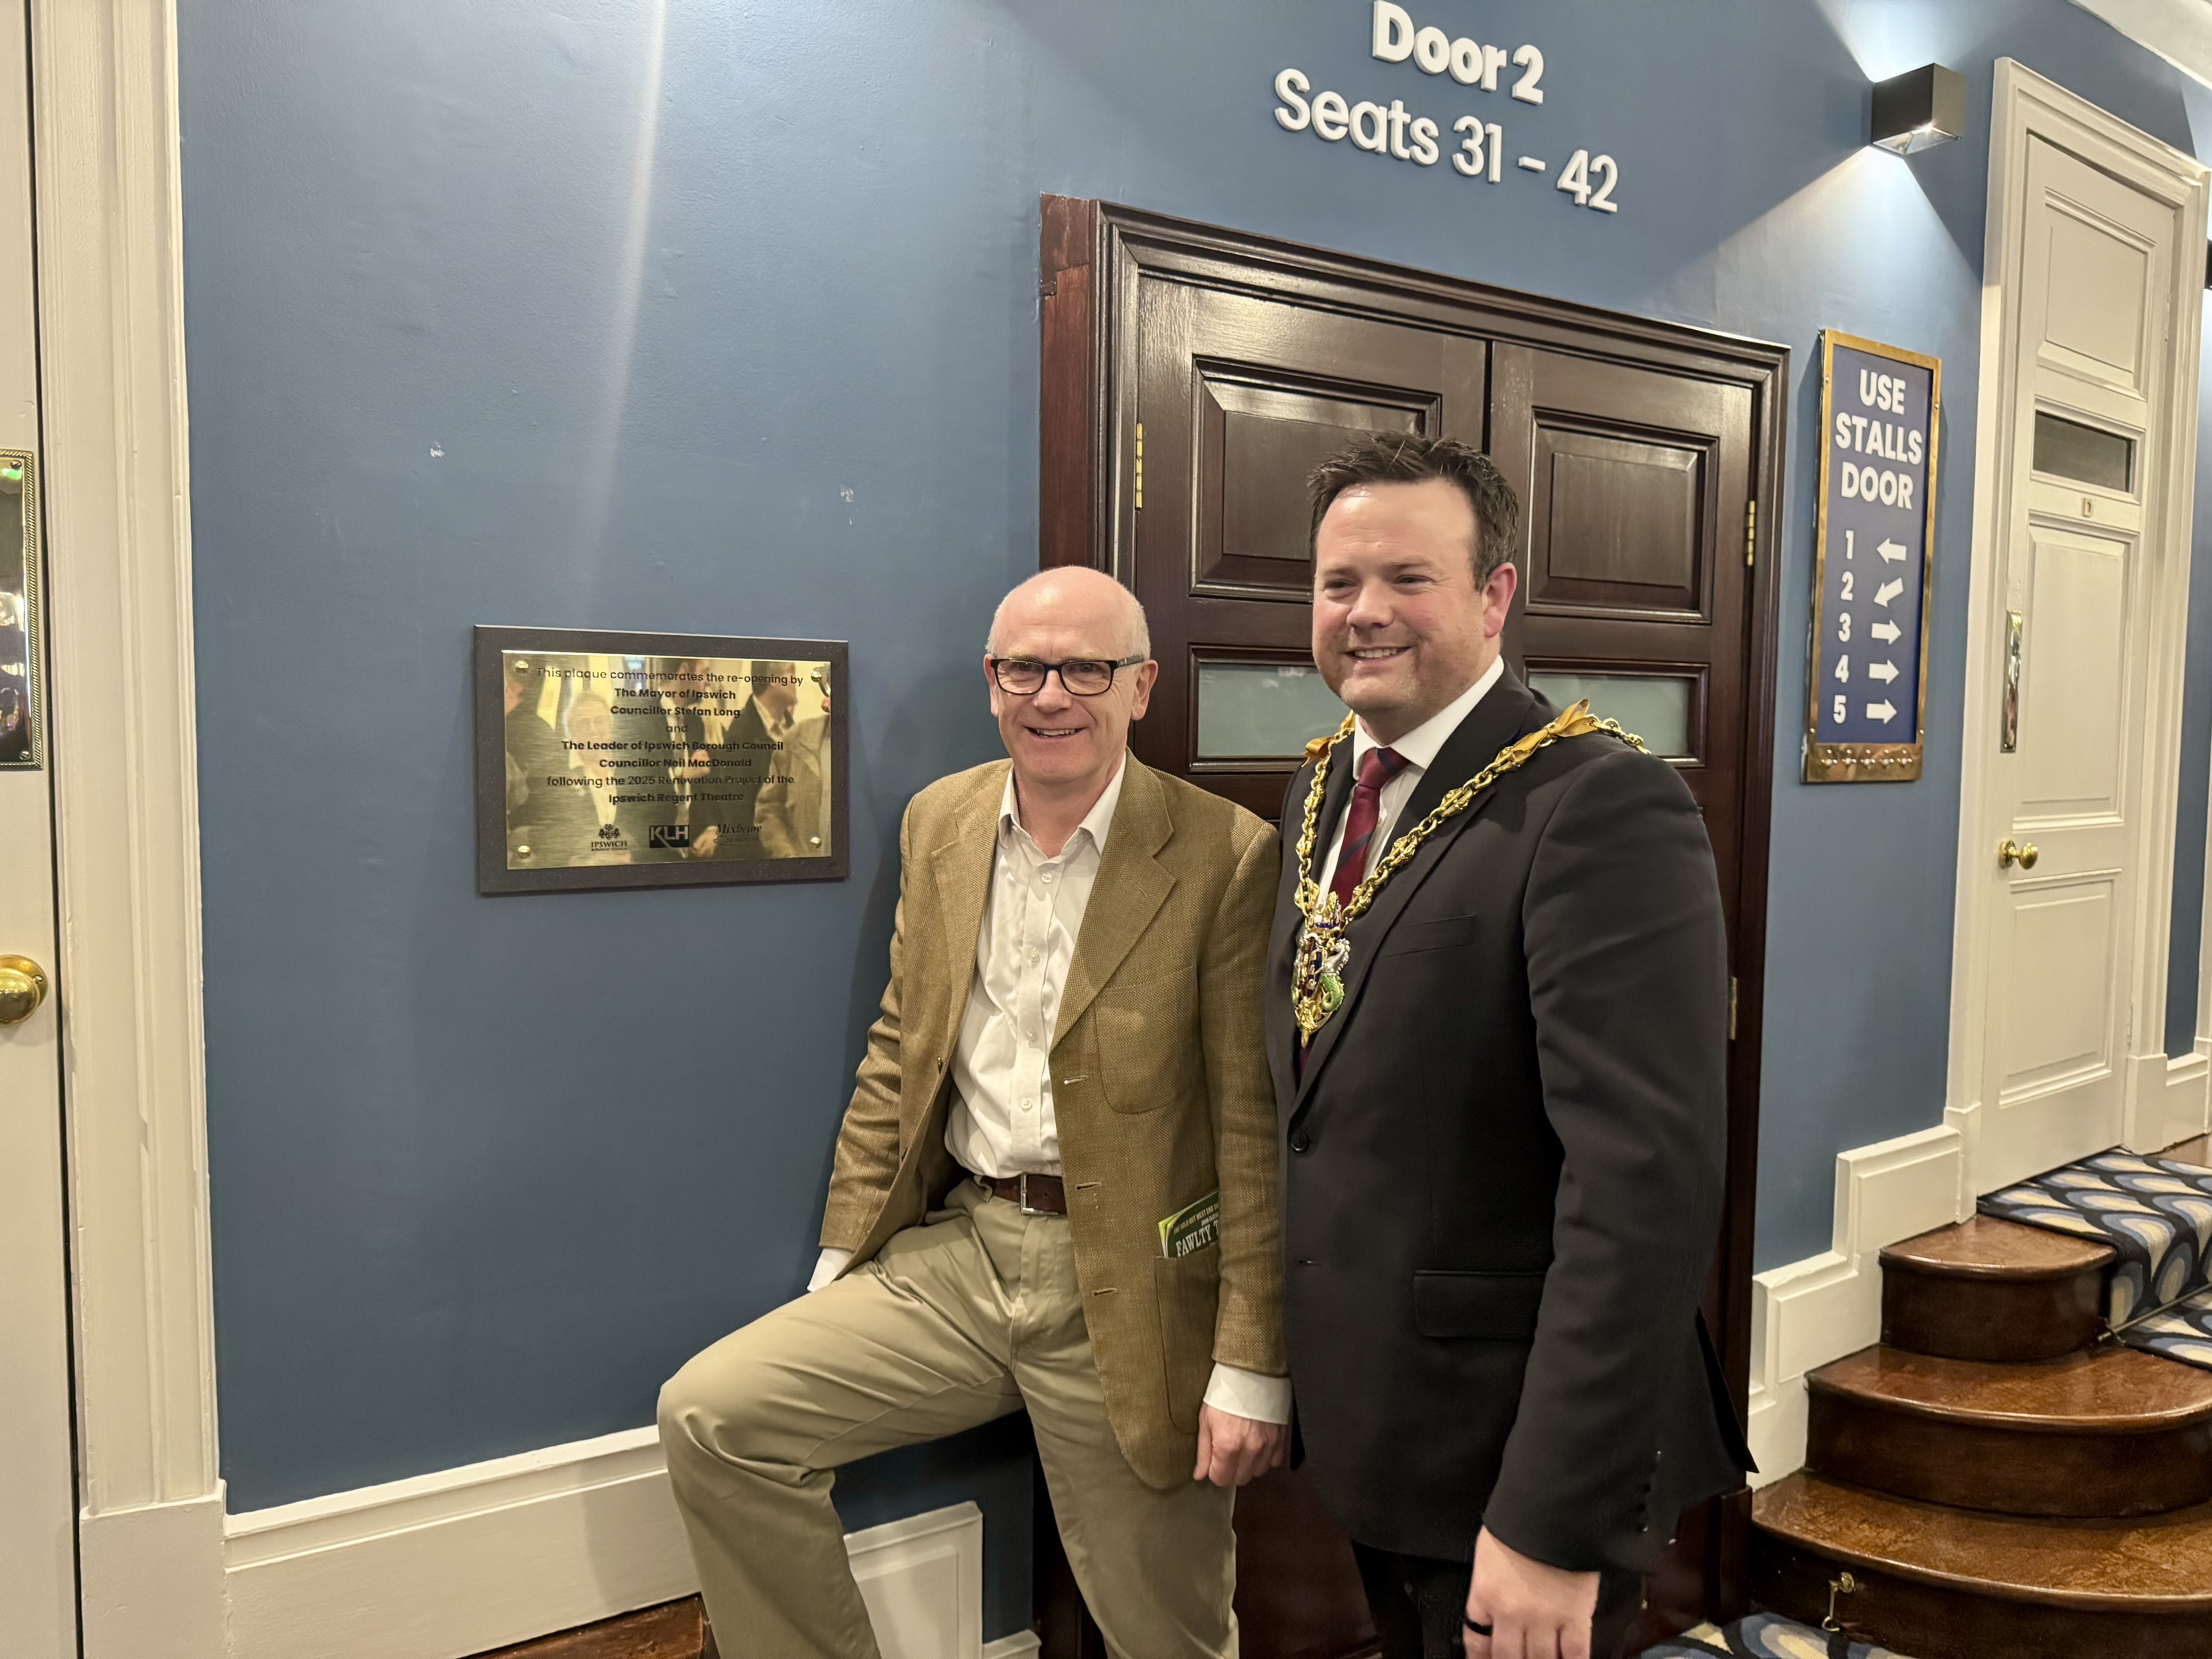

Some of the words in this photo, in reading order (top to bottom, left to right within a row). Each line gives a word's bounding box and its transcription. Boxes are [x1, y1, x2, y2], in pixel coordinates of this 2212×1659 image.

[1372, 0, 1507, 93] Door
[1512, 44, 1544, 105] 2
[1275, 68, 1439, 166] Seats
[1452, 115, 1502, 183] 31
[1556, 149, 1618, 213] 42
[1860, 369, 1905, 415] USE
[1835, 412, 1922, 465] STALLS
[1841, 461, 1913, 510] DOOR
[1846, 529, 1854, 560] 1
[1841, 571, 1853, 601] 2
[1838, 612, 1851, 642] 3
[537, 668, 561, 677] This
[565, 669, 607, 681] plaque
[610, 671, 704, 682] commemorates
[706, 673, 724, 682] the
[727, 674, 788, 686] re-opening
[791, 675, 804, 687] by
[1835, 654, 1849, 683] 4
[615, 688, 637, 697] The
[639, 689, 677, 701] Mayor
[679, 689, 690, 697] of
[692, 690, 736, 700] Ipswich
[1833, 694, 1846, 724] 5
[611, 706, 672, 715] Councillor
[675, 707, 711, 716] Stefan
[714, 708, 740, 718] Long
[666, 725, 688, 733] and
[562, 741, 585, 750] The
[587, 741, 629, 750] Leader
[631, 741, 643, 750] of
[645, 741, 690, 752] Ipswich
[692, 742, 740, 752] Borough
[742, 742, 783, 750] Council
[599, 758, 660, 768] Councillor
[663, 758, 685, 767] Neil
[688, 759, 752, 767] MacDonald
[547, 776, 603, 788] following
[606, 776, 625, 785] the
[628, 776, 656, 785] 2025
[659, 776, 722, 784] Renovation
[725, 776, 761, 785] Project
[764, 775, 775, 784] of
[778, 775, 794, 783] the
[609, 793, 655, 805] Ipswich
[657, 793, 697, 804] Regent
[700, 793, 744, 801] Theatre
[591, 840, 627, 848] IPSWICH
[650, 826, 689, 849] KLH
[1176, 1224, 1212, 1257] FAWLTY
